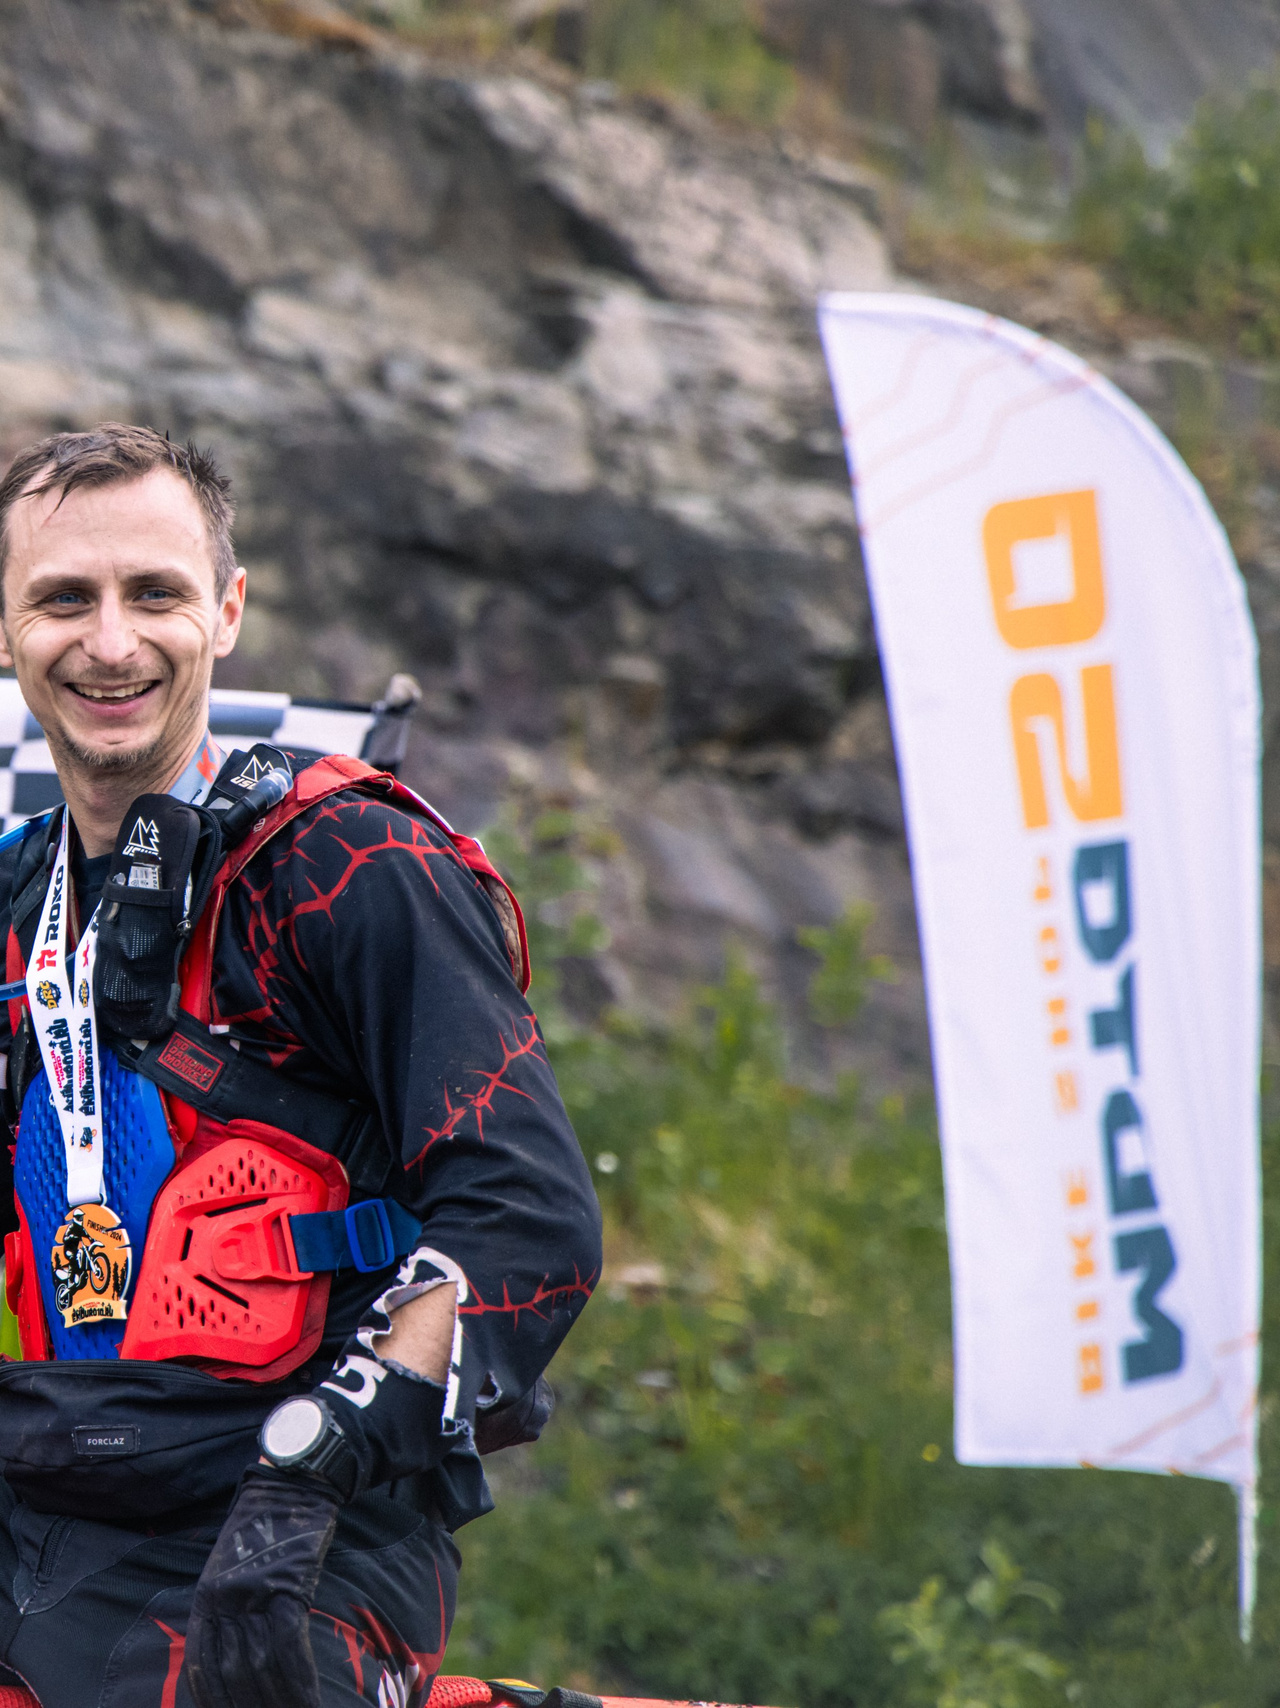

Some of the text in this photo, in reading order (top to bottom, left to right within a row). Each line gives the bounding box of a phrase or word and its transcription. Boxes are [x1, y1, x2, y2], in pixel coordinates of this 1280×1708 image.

[44, 865, 64, 945] ROKO
[39, 981, 60, 1009] DRC
[173, 1038, 189, 1050] NO
[50, 1050, 63, 1088] KARELIA
[164, 1055, 209, 1084] MONKEY
[169, 1047, 214, 1078] DANCING
[110, 1231, 122, 1242] 2024
[87, 1437, 125, 1446] FORCLAZ
